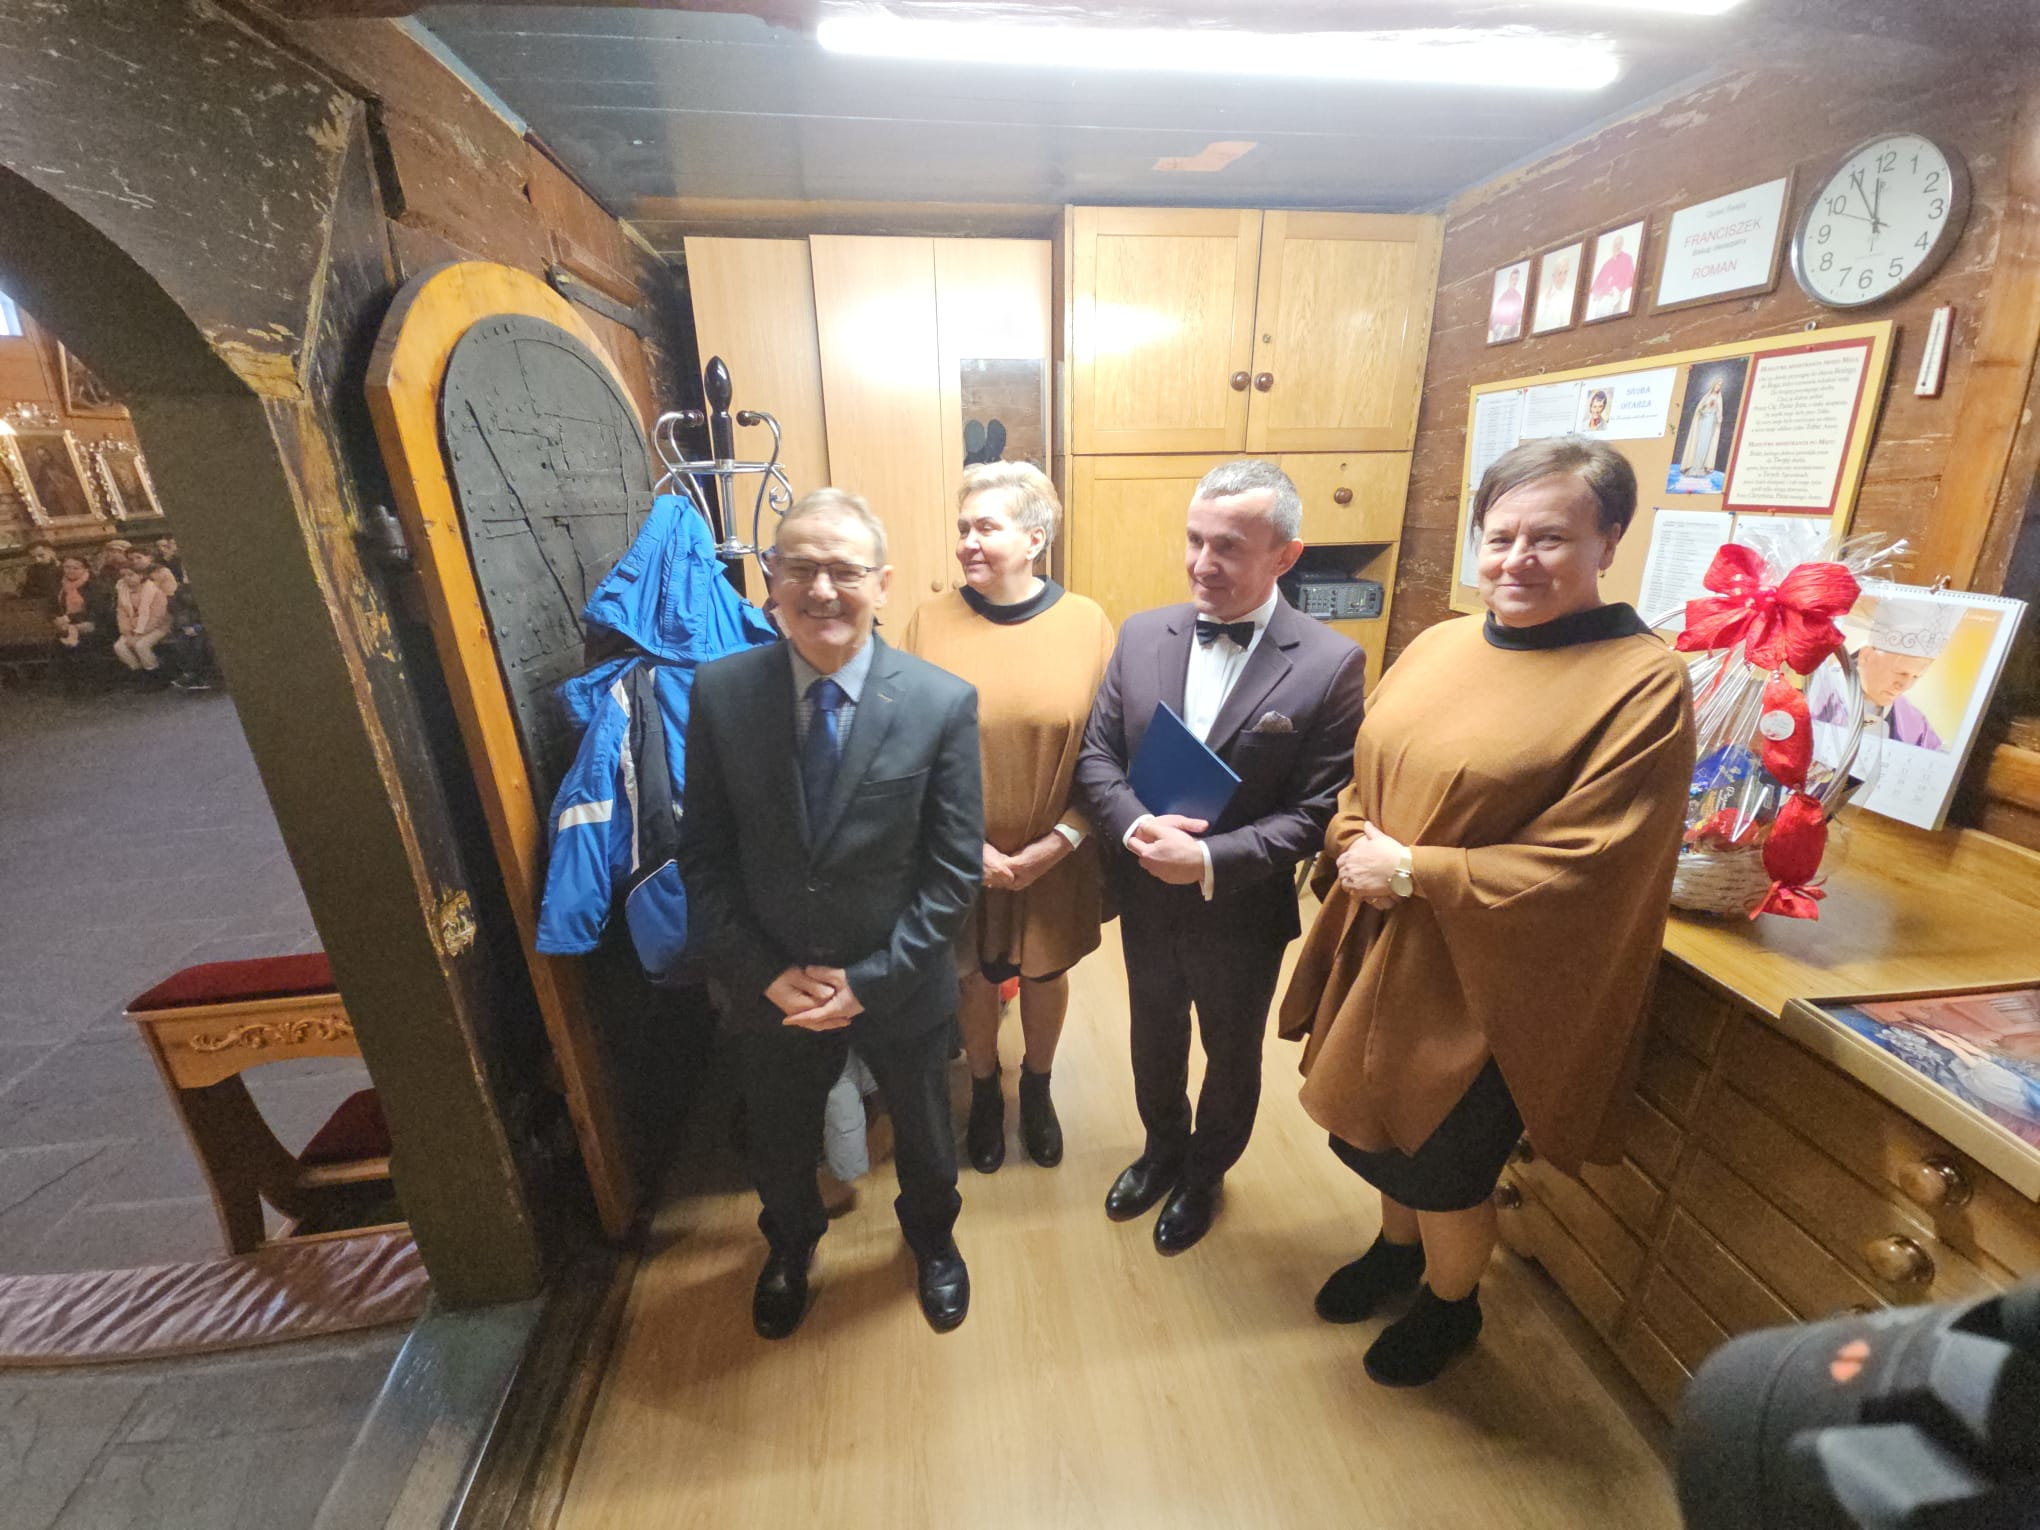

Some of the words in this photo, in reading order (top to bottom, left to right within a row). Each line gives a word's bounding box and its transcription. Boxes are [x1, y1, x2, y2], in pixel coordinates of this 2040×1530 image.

[1875, 151, 1898, 174] 12
[1910, 154, 1919, 175] 1
[1849, 168, 1866, 190] 11
[1923, 171, 1940, 194] 2
[1826, 194, 1847, 217] 10
[1928, 198, 1944, 220] 3
[1683, 216, 1762, 248] FRANCISZEK
[1817, 224, 1832, 244] 9
[1914, 231, 1929, 251] 4
[1691, 259, 1738, 280] ROMAN
[1819, 252, 1834, 272] 8
[1888, 257, 1904, 278] 5
[1839, 267, 1852, 287] 7
[1858, 269, 1874, 289] 6
